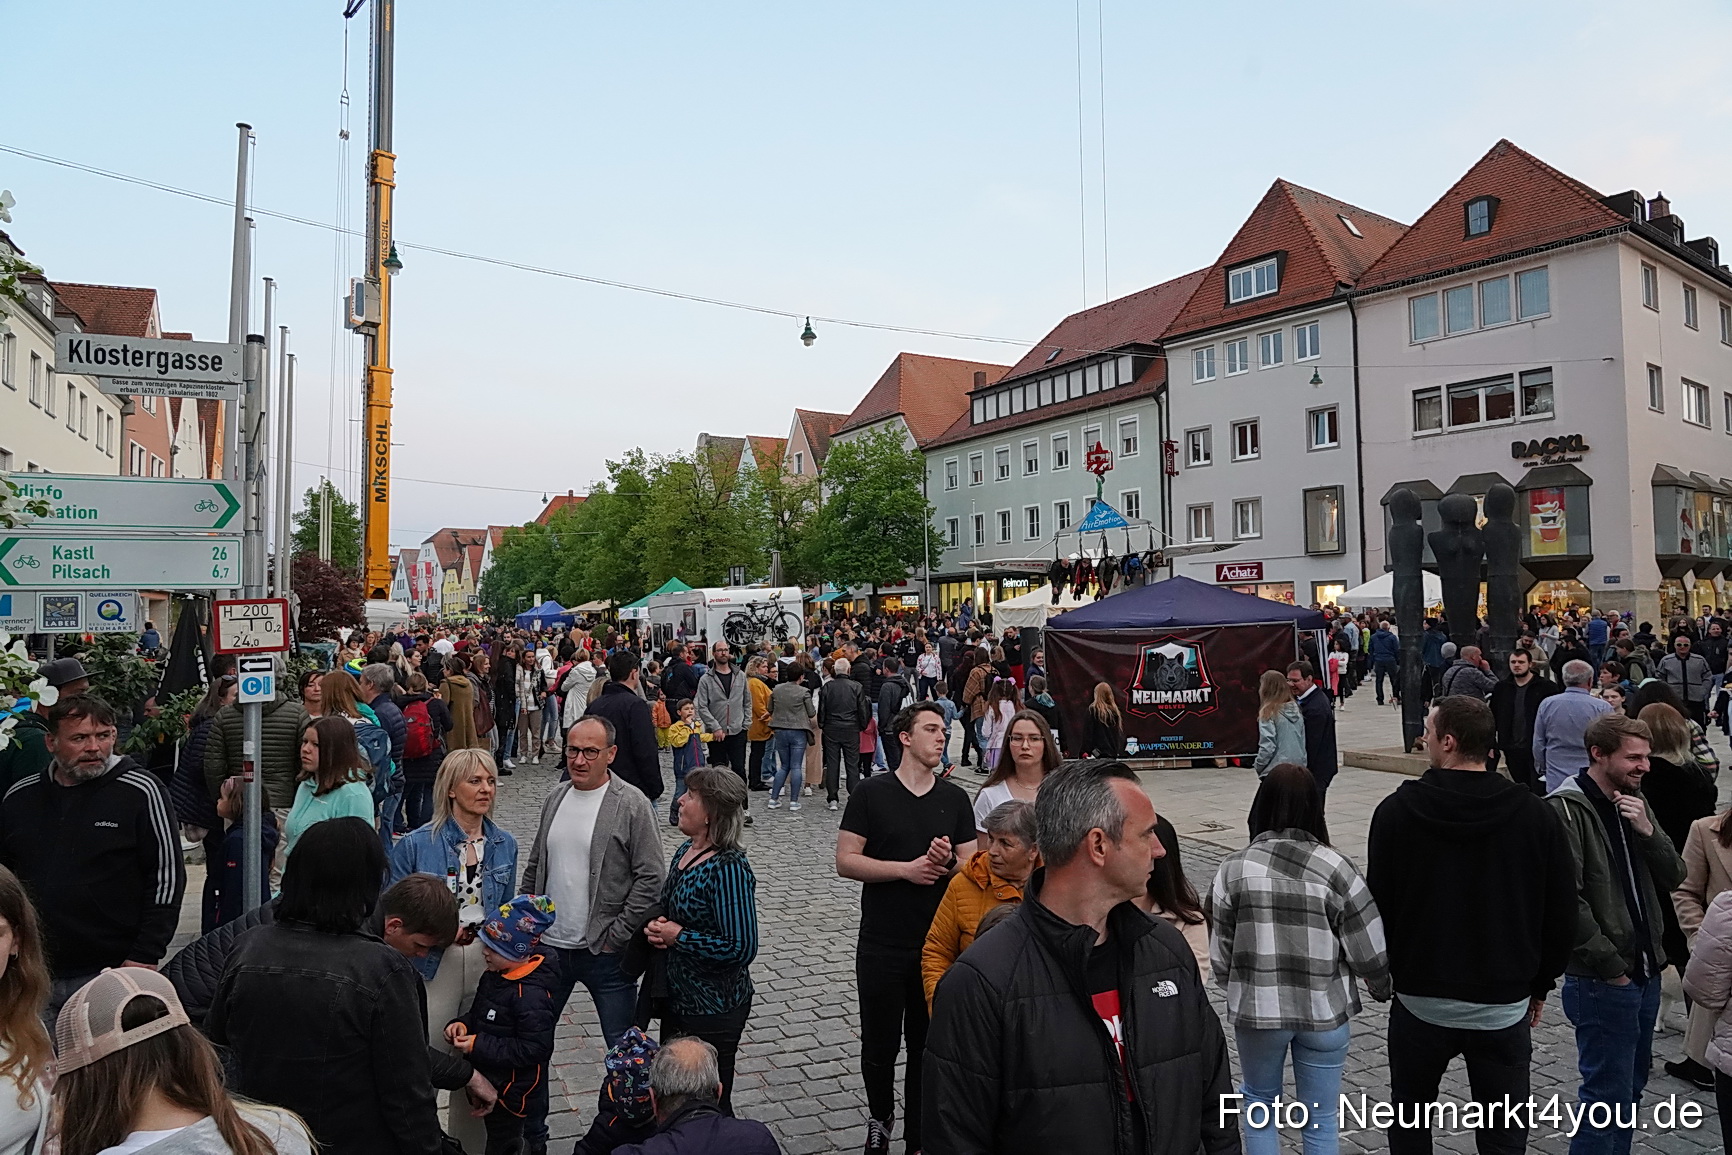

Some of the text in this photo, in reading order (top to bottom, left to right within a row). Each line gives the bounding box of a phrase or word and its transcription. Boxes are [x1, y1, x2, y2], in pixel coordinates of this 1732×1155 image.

[68, 339, 223, 375] Klostergasse
[146, 380, 177, 389] vormaligen
[168, 388, 203, 397] säkularisiert
[1512, 434, 1590, 459] RACKL
[374, 419, 387, 503] MIKSCHL
[1540, 455, 1583, 465] Rathaus
[1081, 516, 1121, 530] AirEmotion
[52, 545, 227, 561] Kastl 26
[52, 564, 229, 580] Pilsach 6,7
[1220, 564, 1258, 580] Achatz
[223, 604, 269, 618] H 200
[1132, 687, 1212, 704] NEUMARKT
[1140, 741, 1214, 751] WAPPENWUNDER.DE
